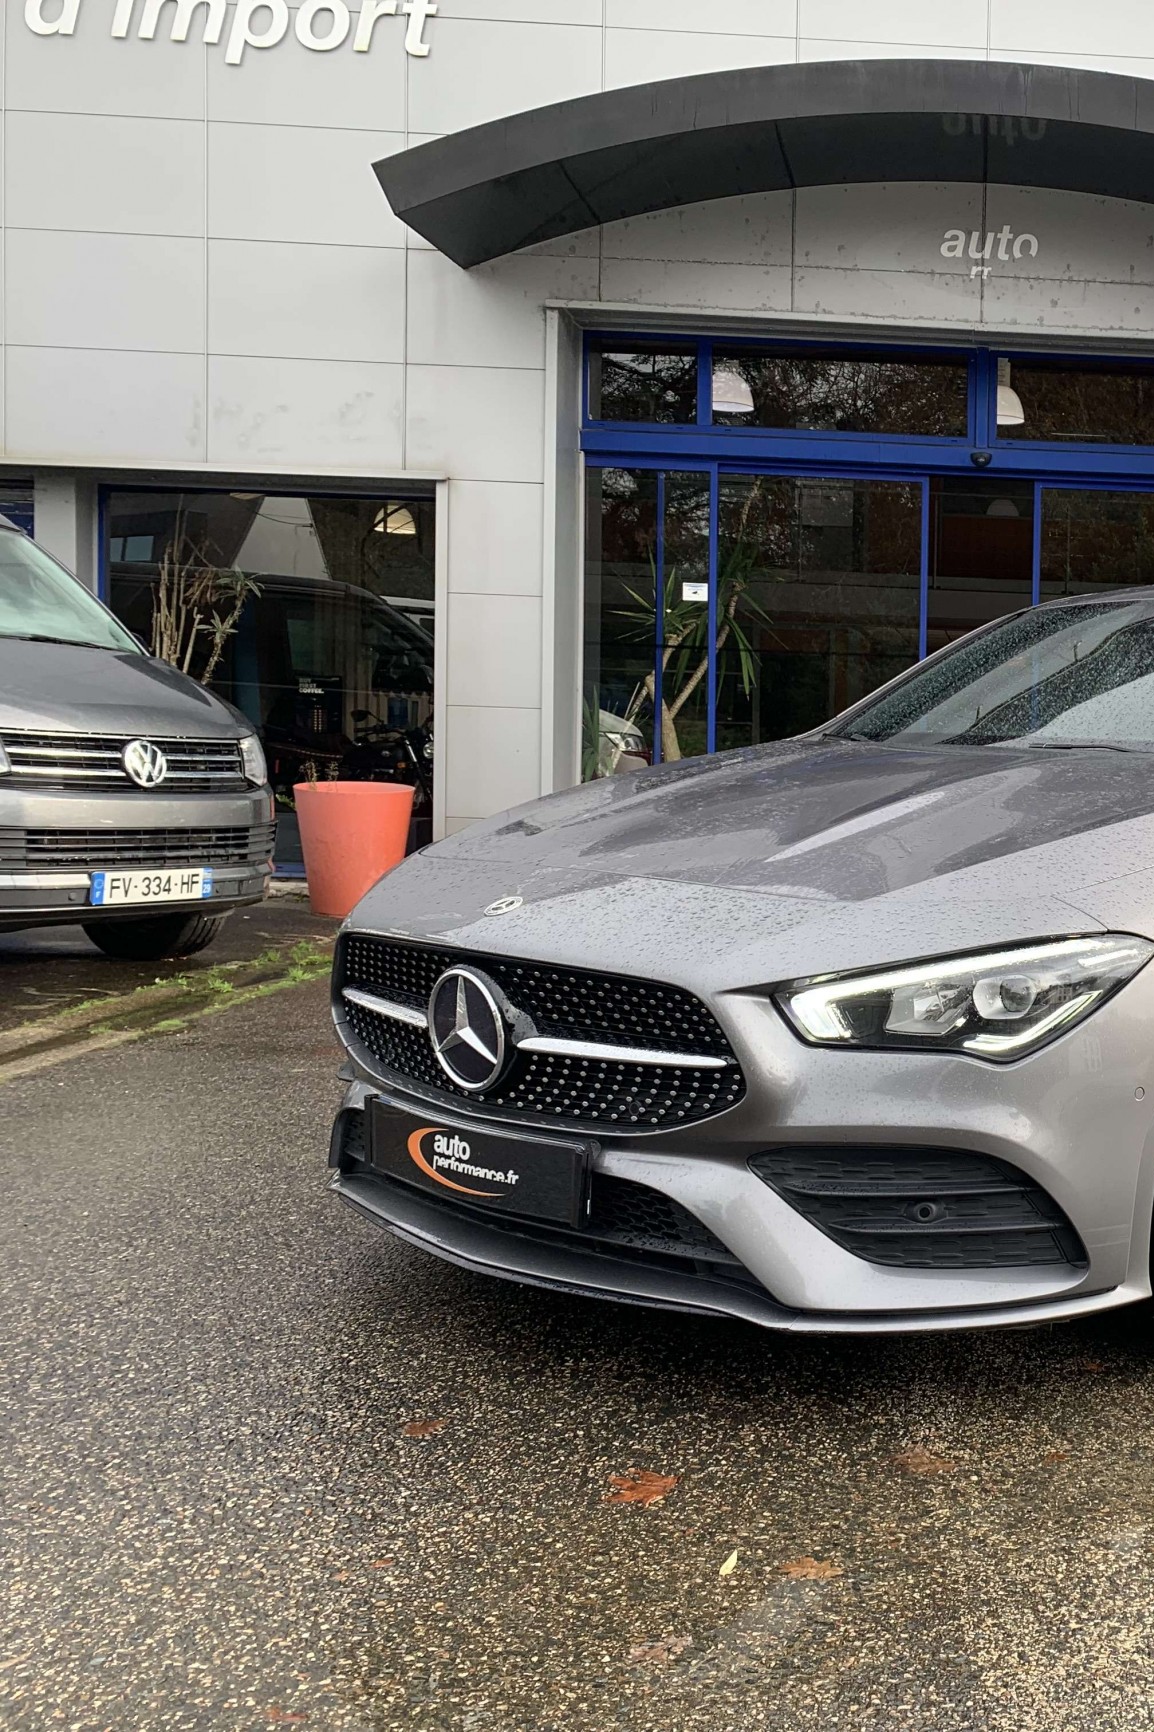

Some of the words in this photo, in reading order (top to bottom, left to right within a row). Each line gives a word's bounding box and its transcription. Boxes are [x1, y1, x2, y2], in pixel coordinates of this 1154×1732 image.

[940, 225, 1039, 261] auto
[433, 1134, 471, 1160] auto
[432, 1155, 519, 1184] performance.fr
